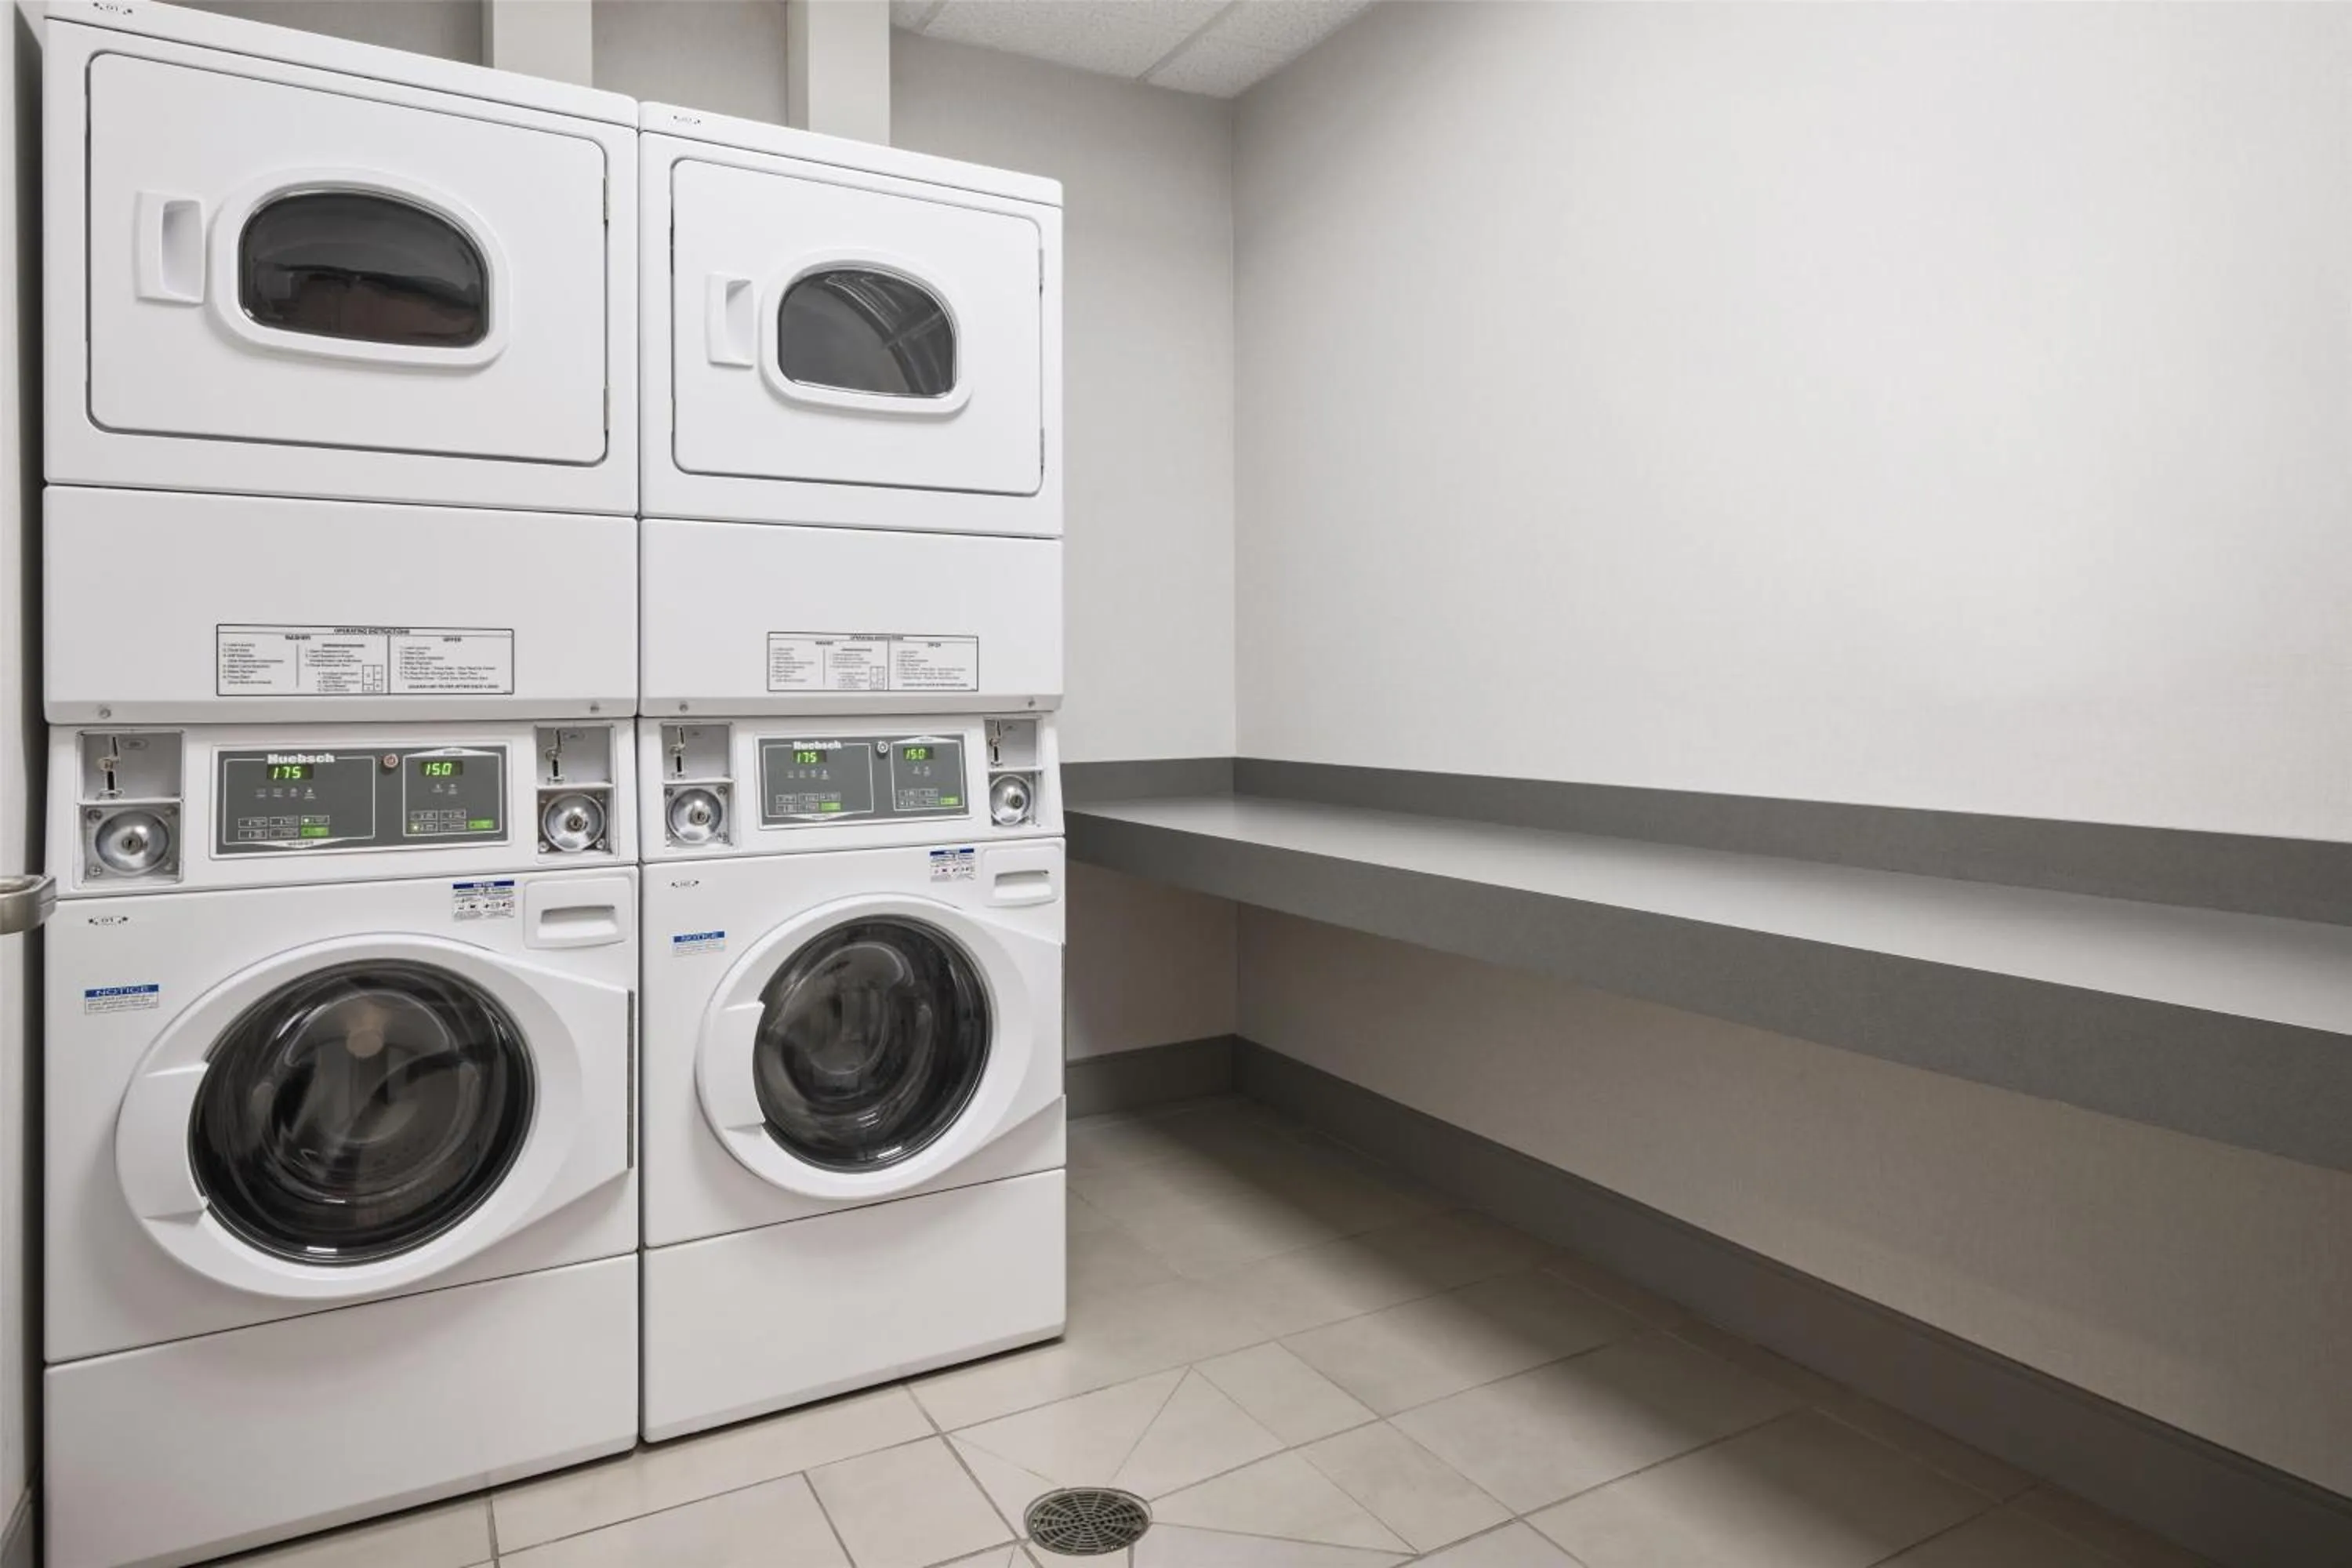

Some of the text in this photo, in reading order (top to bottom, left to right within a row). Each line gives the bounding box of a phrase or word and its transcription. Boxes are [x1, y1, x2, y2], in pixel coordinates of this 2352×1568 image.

[267, 753, 336, 765] Huebsch
[797, 752, 817, 764] 175
[906, 748, 926, 760] 150
[272, 766, 302, 780] 175
[426, 762, 452, 775] 150
[96, 987, 149, 996] NOTICE
